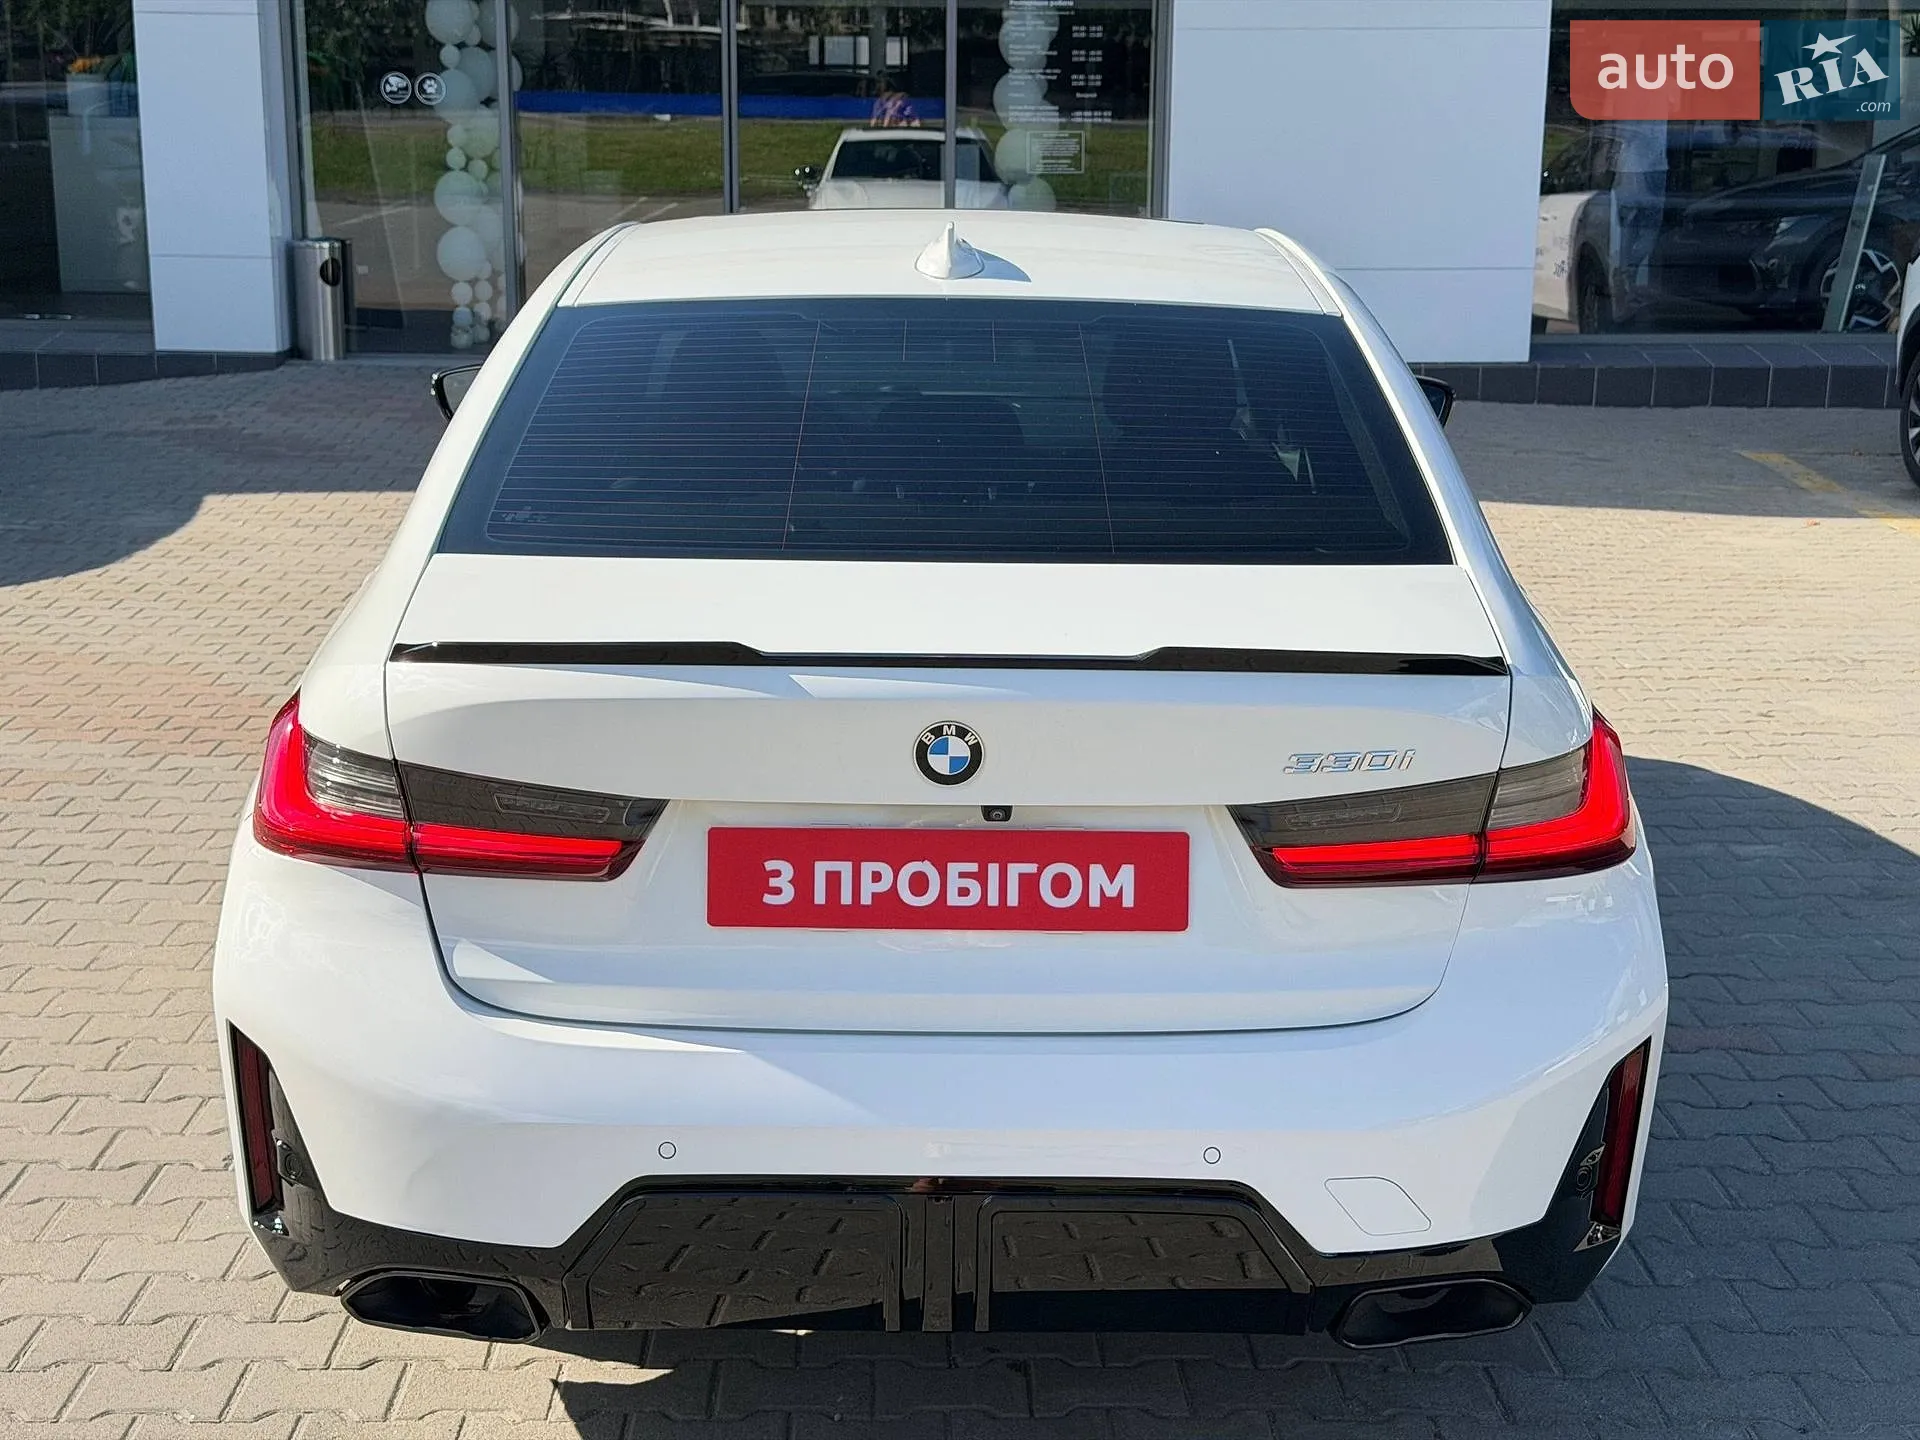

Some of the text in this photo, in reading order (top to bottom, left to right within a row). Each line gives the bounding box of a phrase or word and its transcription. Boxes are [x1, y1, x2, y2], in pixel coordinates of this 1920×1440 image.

[921, 724, 979, 746] BMW
[1283, 748, 1416, 775] 330i
[813, 860, 1136, 909] ПРОБІГОМ
